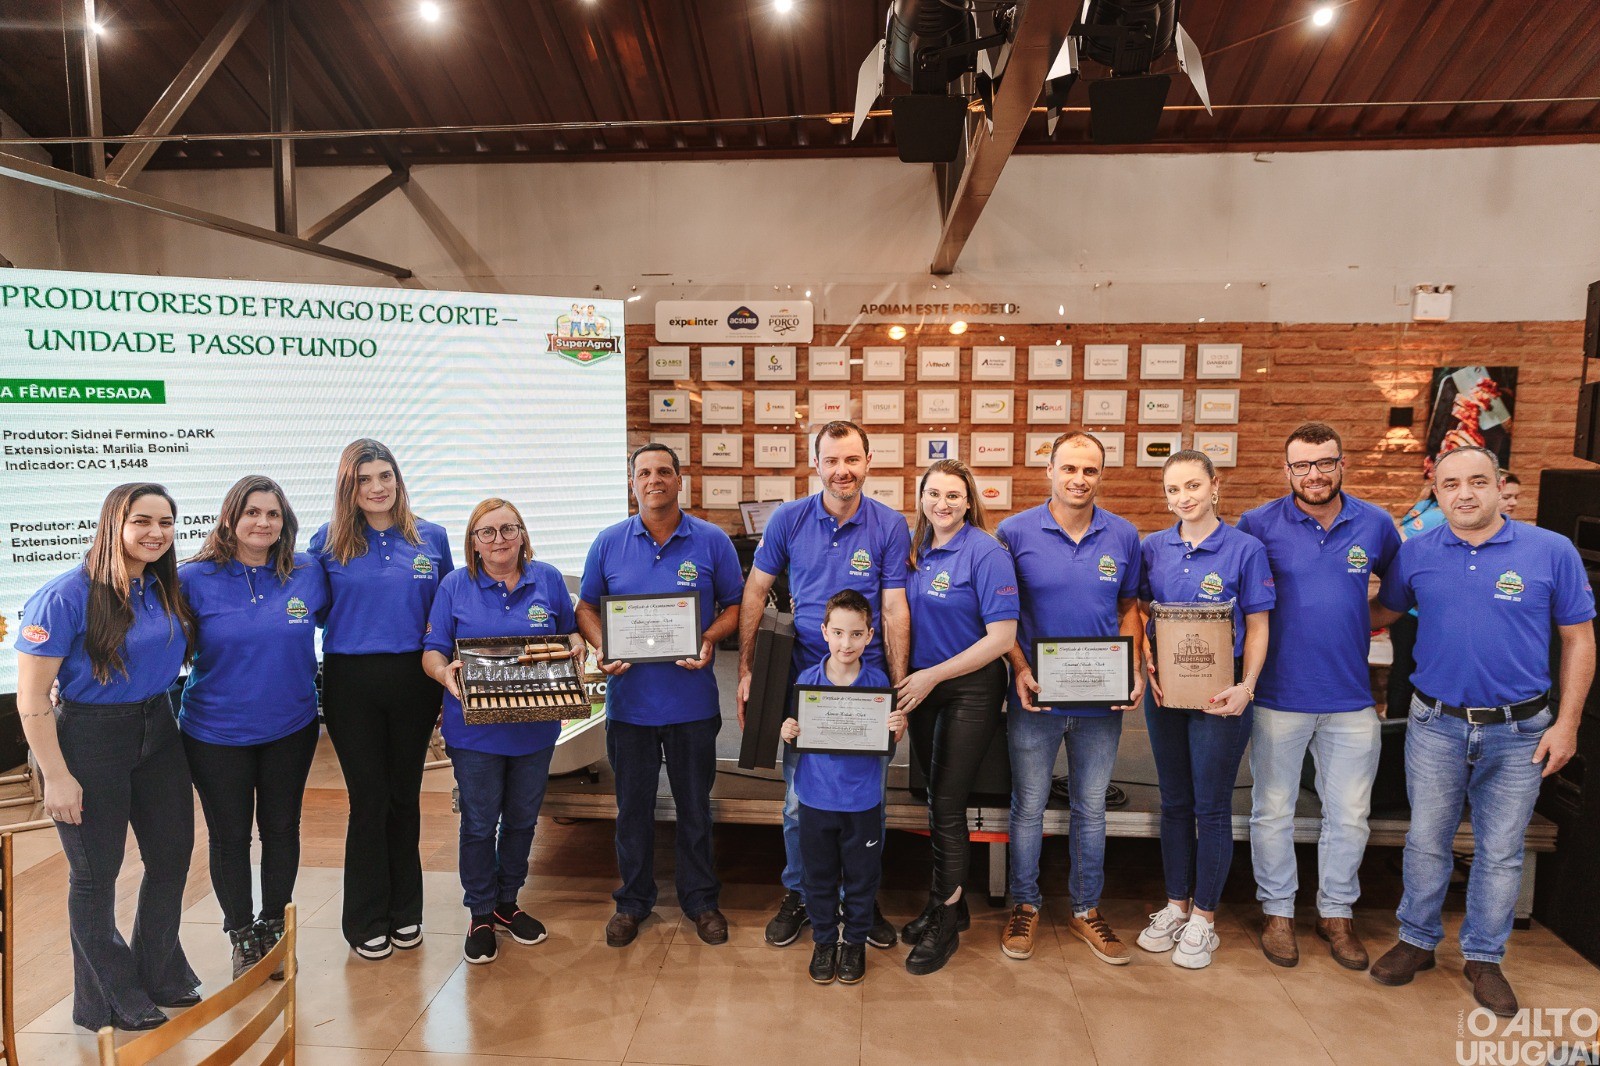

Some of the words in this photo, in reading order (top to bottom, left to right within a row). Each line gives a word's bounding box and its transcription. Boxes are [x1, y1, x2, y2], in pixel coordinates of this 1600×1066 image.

[2, 284, 212, 315] PRODUTORES
[219, 295, 257, 317] DE
[264, 297, 374, 321] FRANGO
[380, 302, 414, 322] DE
[419, 304, 498, 326] CORTE
[860, 303, 912, 316] APOIAM
[916, 303, 949, 315] ESTE
[953, 302, 1020, 315] PROJETO:
[768, 318, 800, 327] PORCO
[26, 328, 175, 353] UNIDADE
[188, 333, 275, 356] PASSO
[280, 336, 377, 358] FUNDO
[556, 338, 613, 350] SuperAgro
[19, 384, 80, 399] FÊMEA
[85, 387, 152, 399] PESADA
[3, 429, 68, 440] Produtor:
[71, 429, 112, 440] Sidnei
[115, 428, 168, 440] Fermino
[177, 428, 215, 439] DARK
[4, 445, 99, 455] Extensionista:
[148, 442, 189, 453] Bonini
[6, 460, 75, 471] Indicador:
[77, 459, 107, 470] CAC
[110, 458, 149, 471] 1,5448
[10, 520, 75, 533] Produtor:
[13, 552, 81, 563] Indicador:
